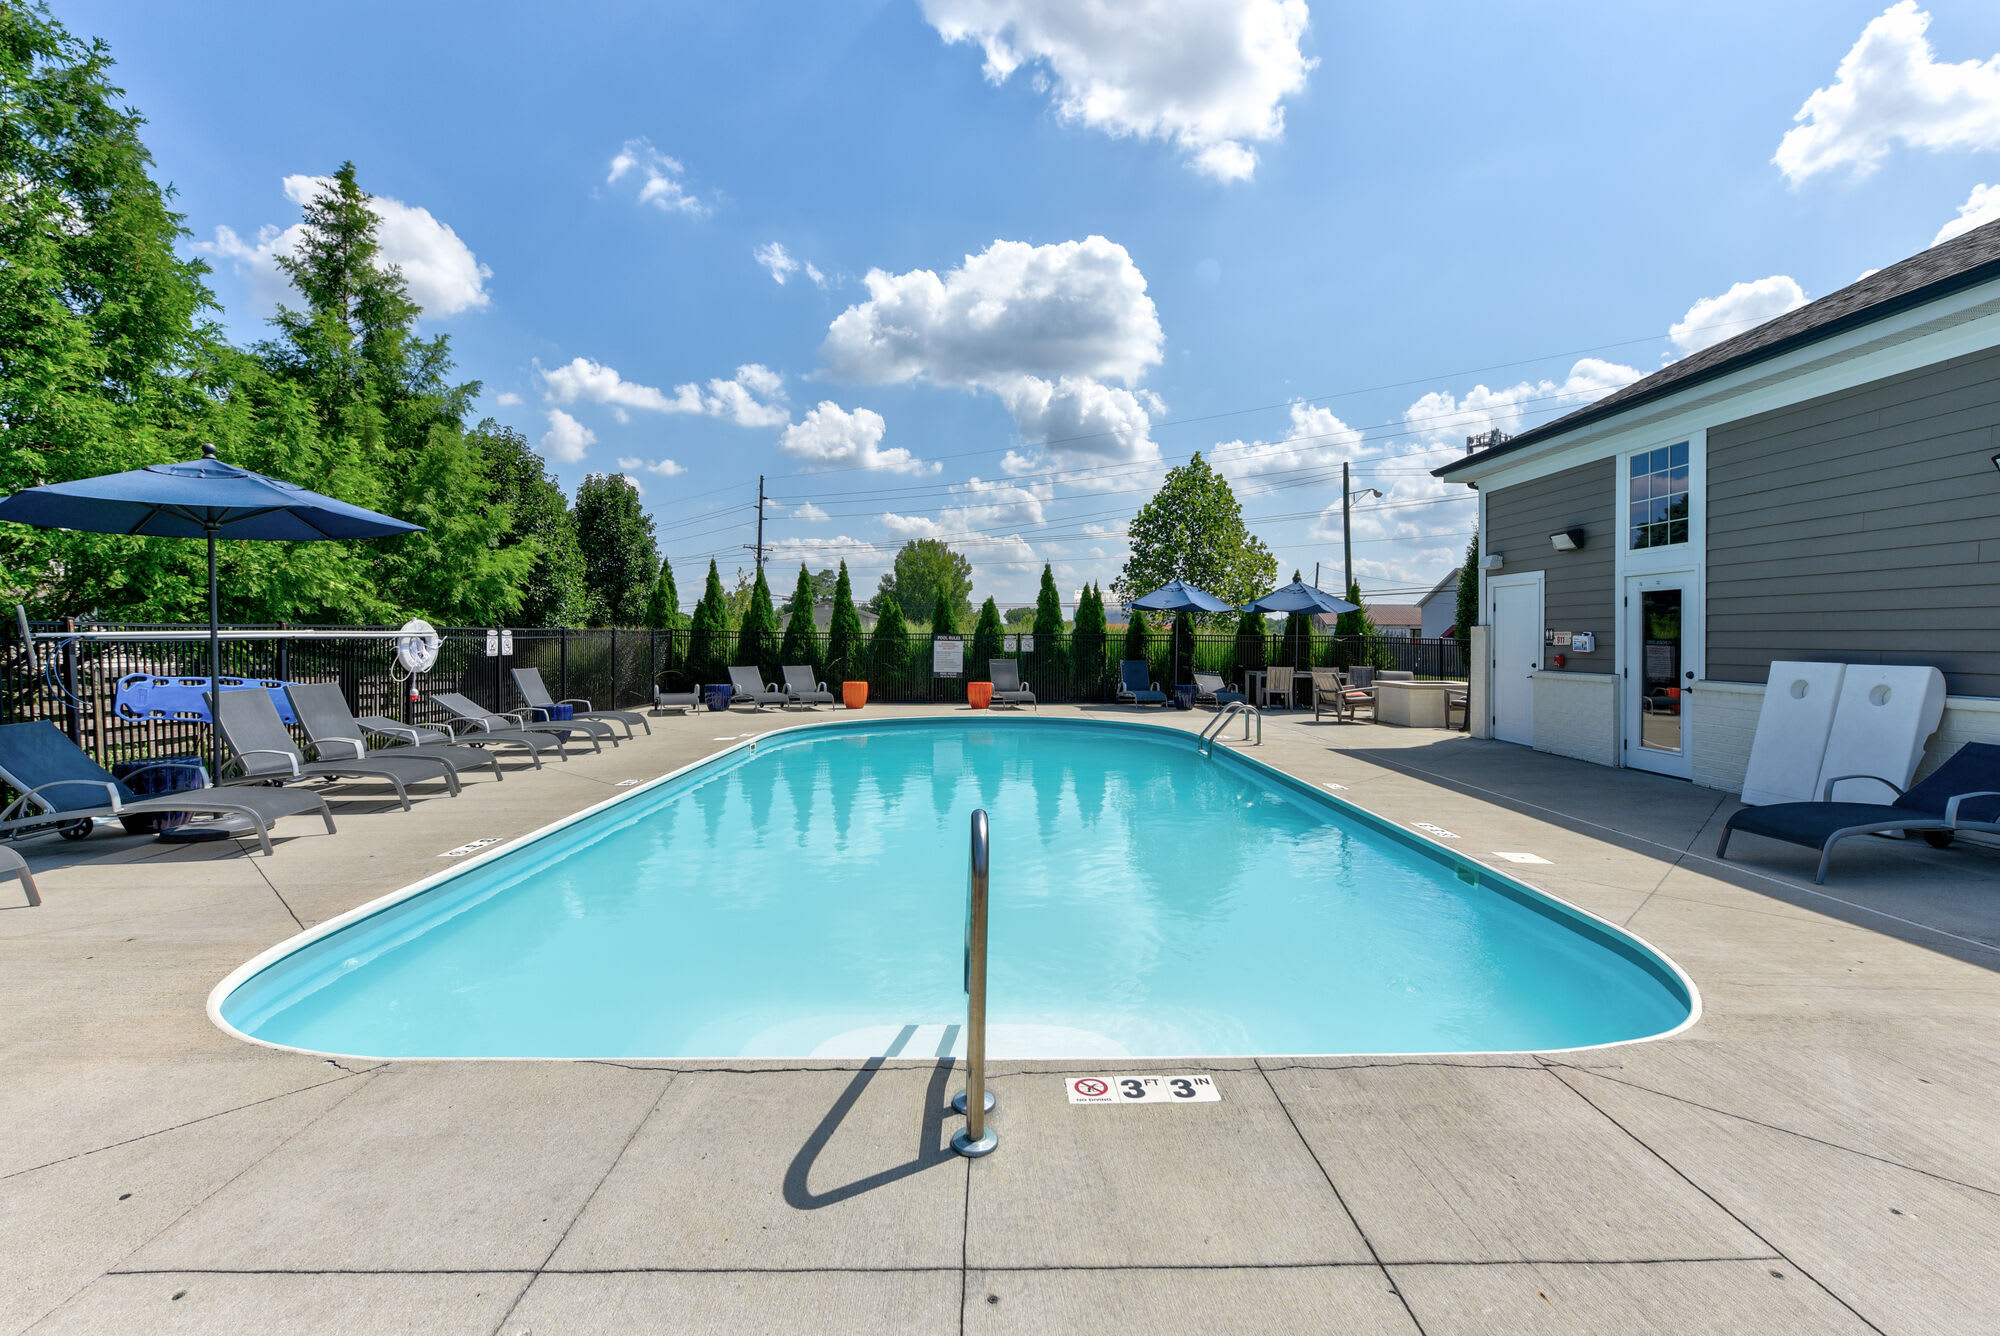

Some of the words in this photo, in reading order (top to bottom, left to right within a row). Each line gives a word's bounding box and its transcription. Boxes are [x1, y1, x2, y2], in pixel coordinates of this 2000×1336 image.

[1557, 636, 1565, 644] 911
[1120, 1079, 1146, 1098] 3
[1170, 1079, 1197, 1098] 3
